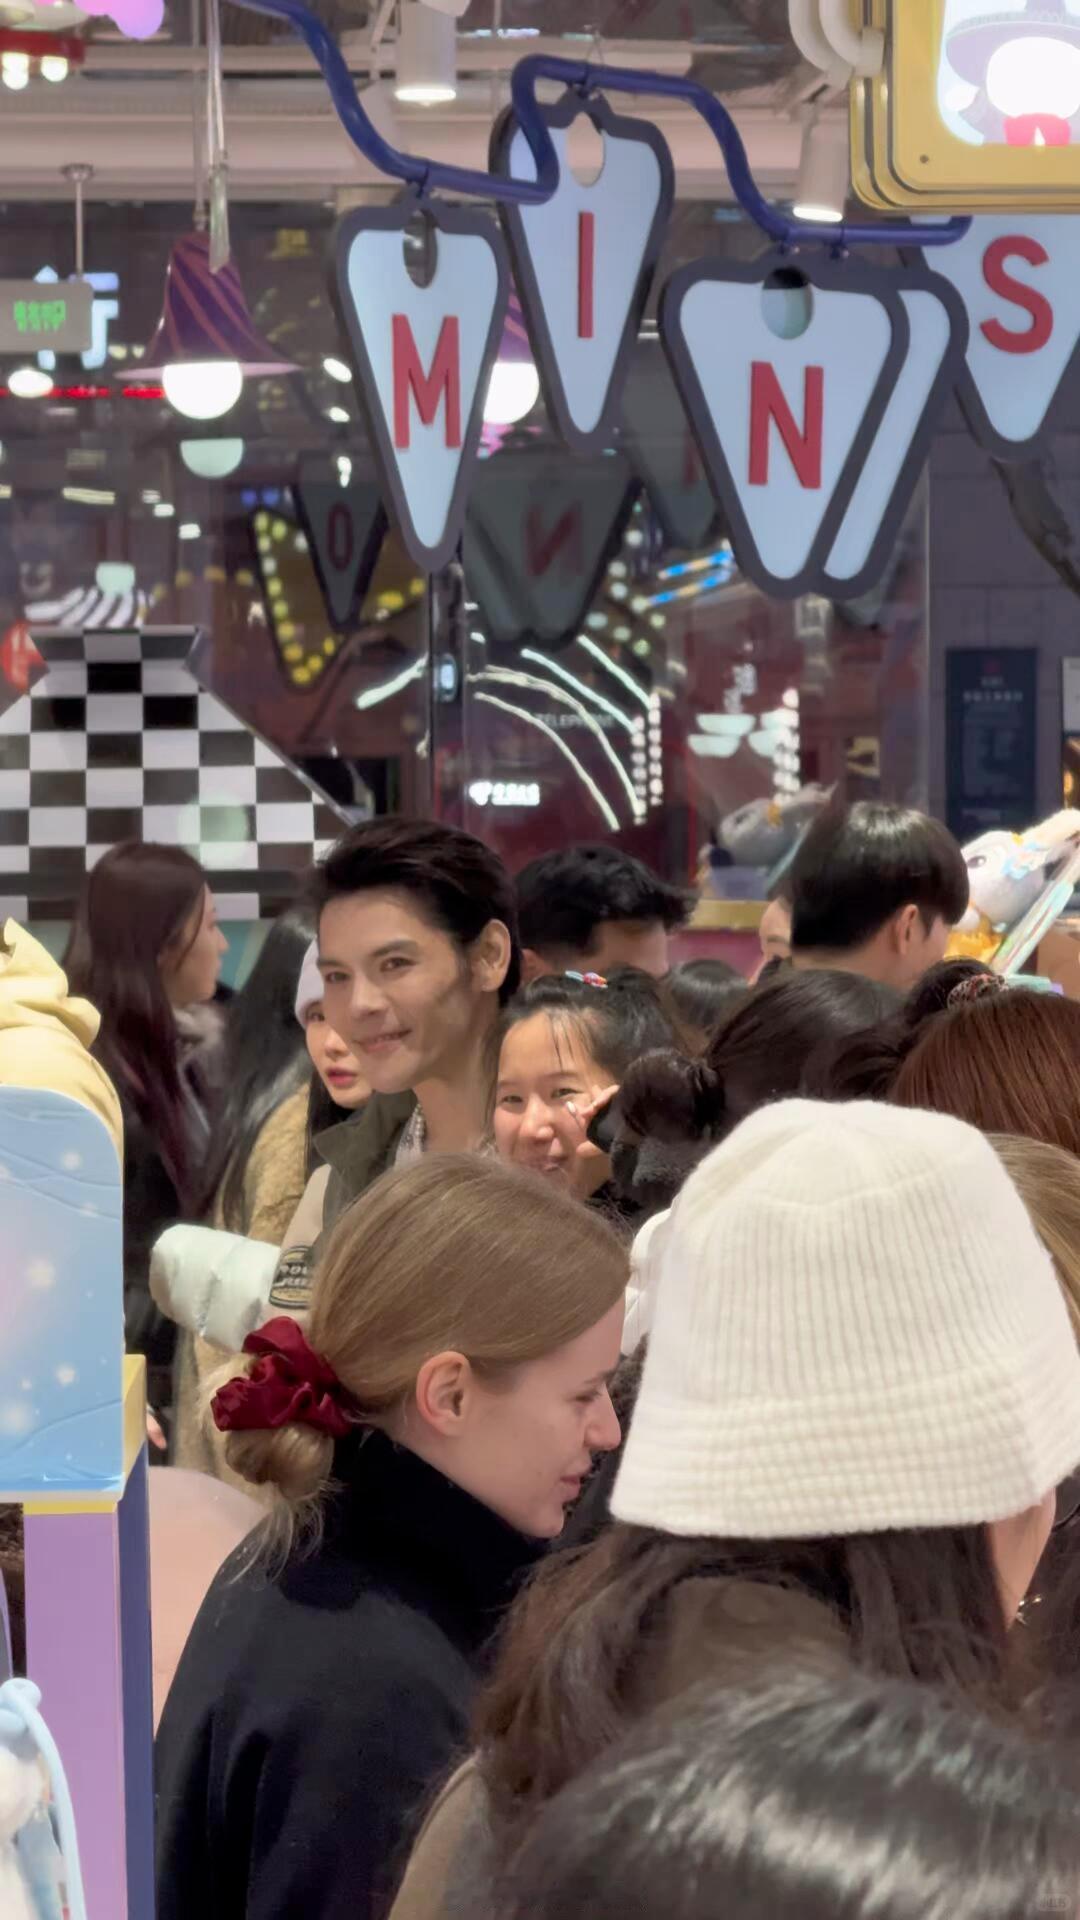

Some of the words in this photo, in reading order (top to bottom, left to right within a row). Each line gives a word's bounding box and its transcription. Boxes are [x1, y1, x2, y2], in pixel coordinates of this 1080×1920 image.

[392, 315, 461, 449] M
[578, 212, 594, 338] I
[748, 361, 824, 489] N
[980, 235, 1053, 353] S
